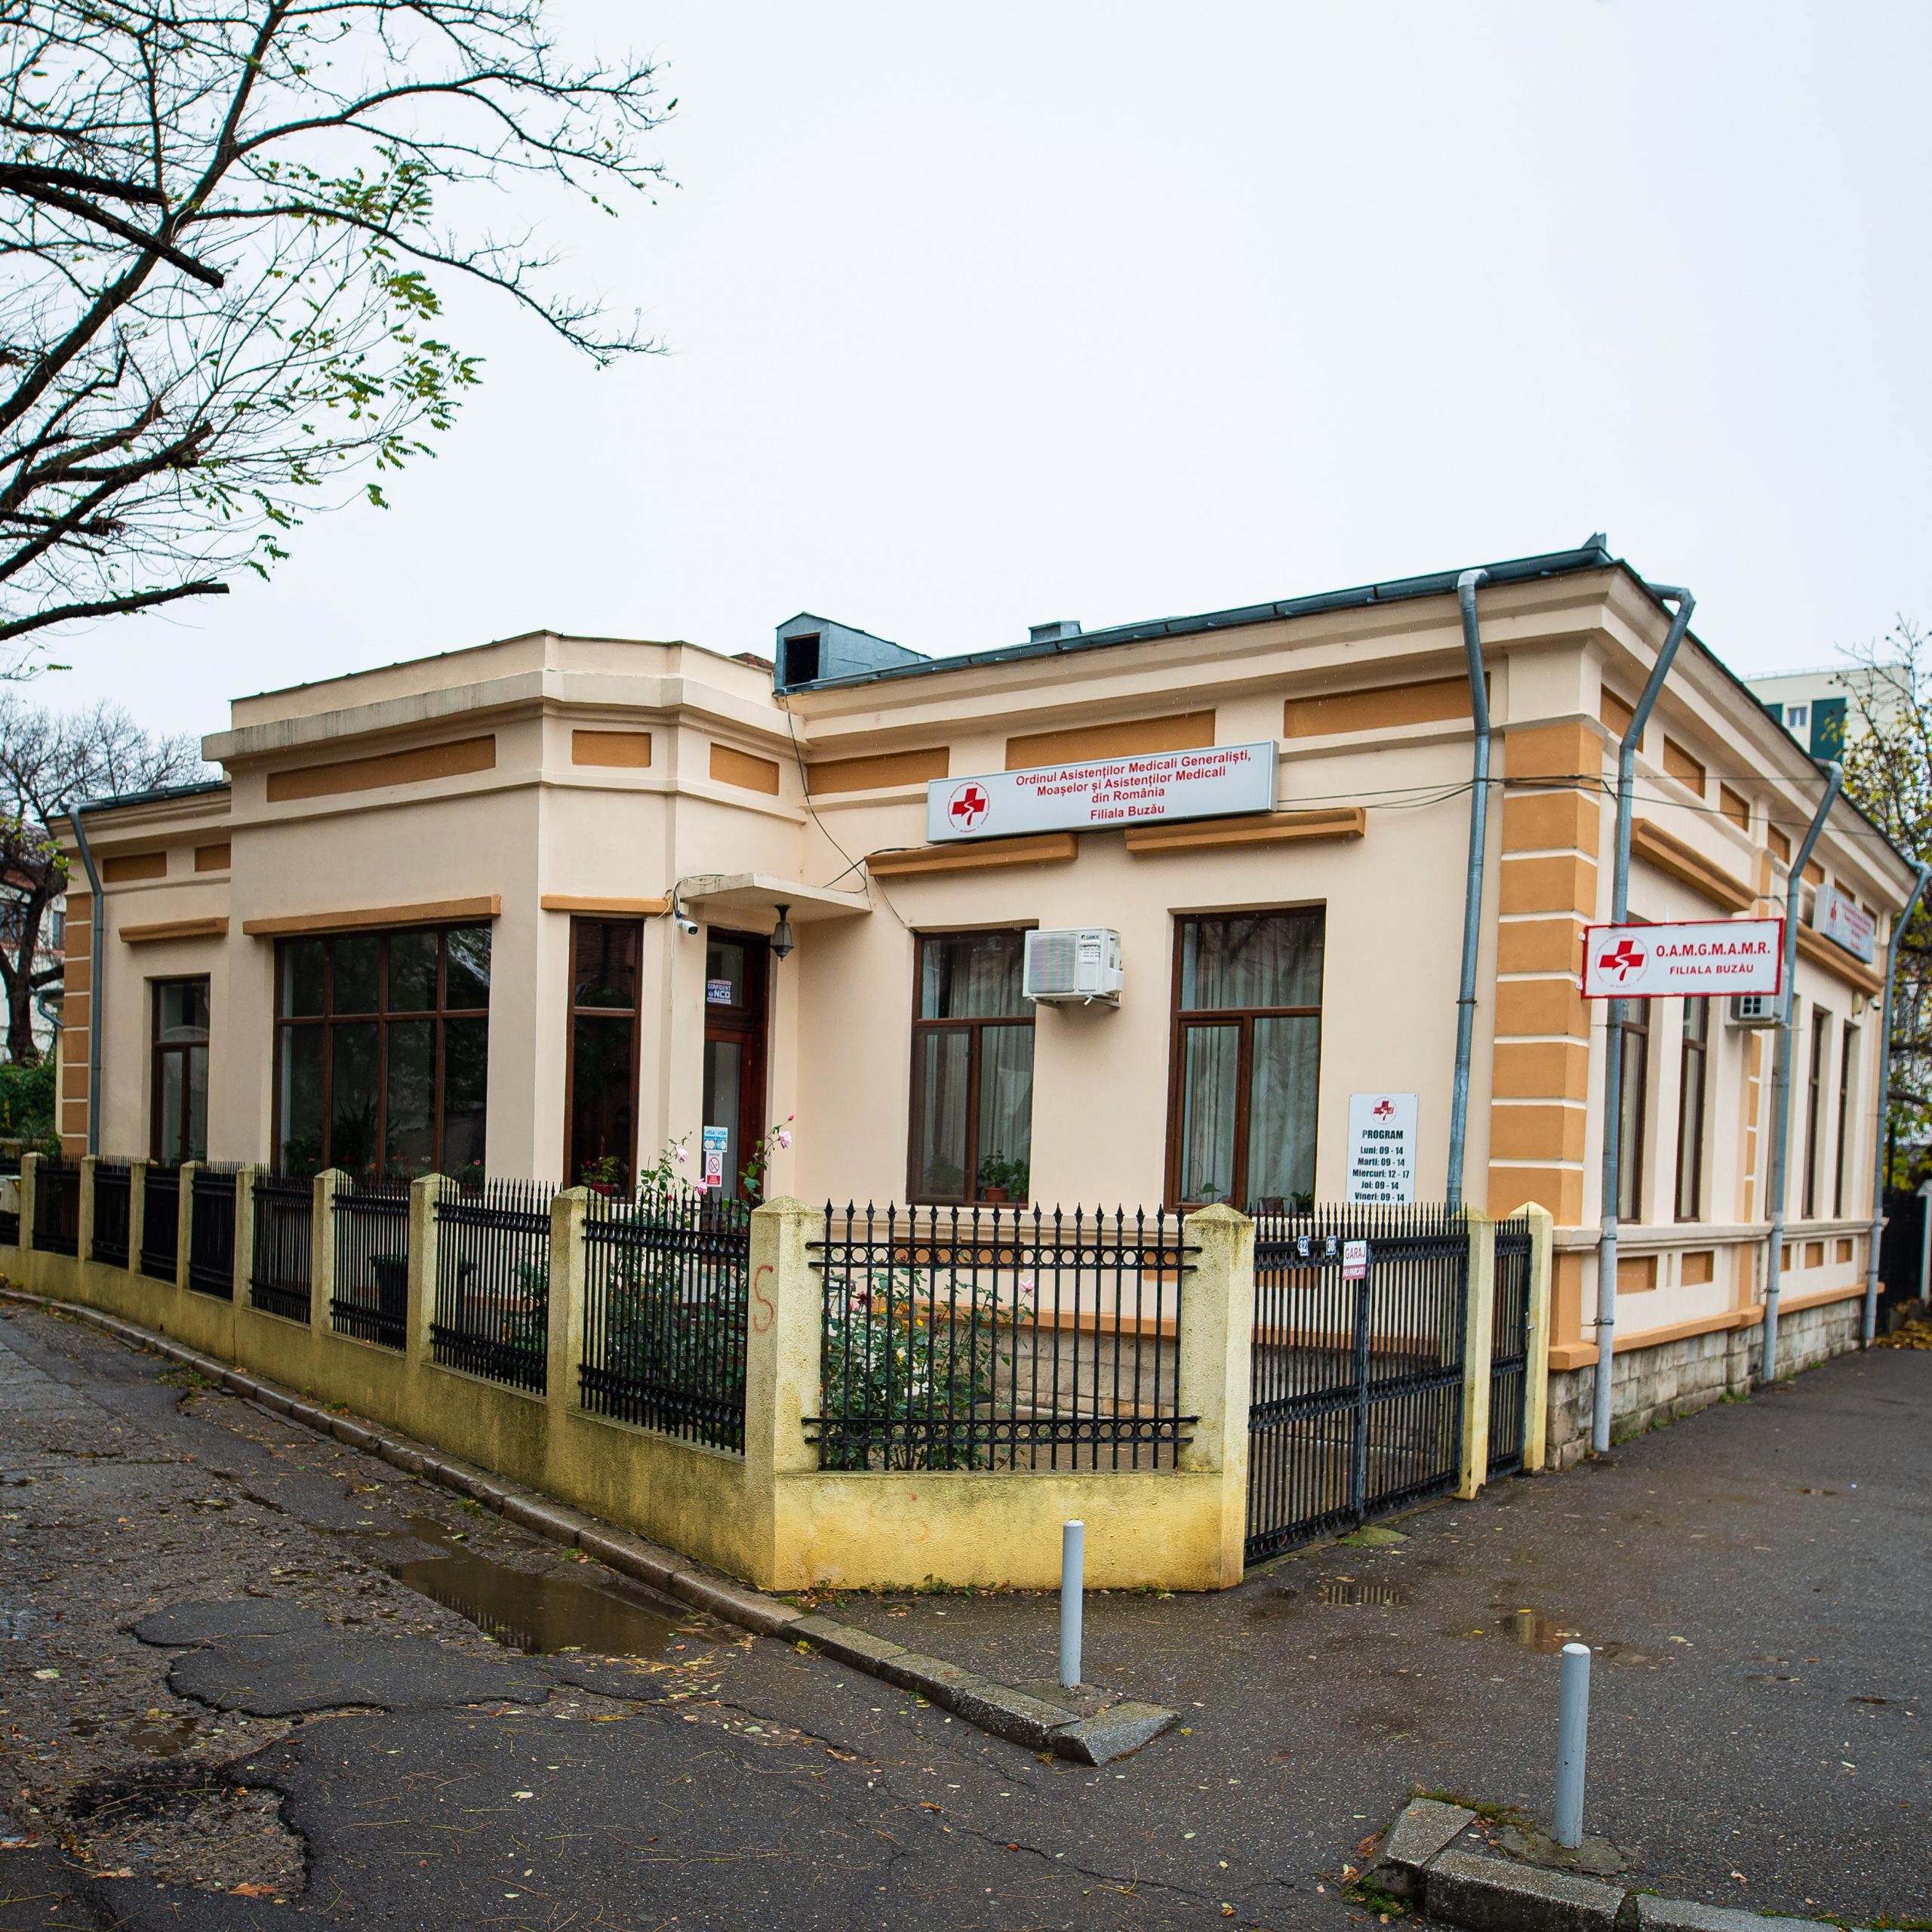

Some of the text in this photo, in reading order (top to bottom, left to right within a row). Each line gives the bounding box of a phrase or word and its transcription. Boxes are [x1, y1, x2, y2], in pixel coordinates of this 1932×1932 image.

[1016, 749, 1251, 786] Ordinul Asistenților Medicali Generaliști,
[1037, 765, 1226, 797] Moașelor și Asistenților Medicali
[1092, 786, 1165, 803] din România
[1091, 803, 1164, 820] Filiala Buzău
[1656, 942, 1770, 958] O.A.M.G.M.A.M.R.
[1669, 965, 1712, 975] FILIALA
[1362, 1130, 1404, 1140] PROGRAM
[1360, 1146, 1378, 1154] Luni:
[1379, 1146, 1389, 1155] 09
[1395, 1146, 1404, 1155] 14
[1380, 1158, 1391, 1166] 09
[1397, 1158, 1405, 1167] 14
[1352, 1169, 1386, 1177] Miercuri:
[1388, 1170, 1396, 1178] 12
[1402, 1170, 1410, 1179] 17
[1361, 1180, 1374, 1189] Joi:
[1374, 1181, 1385, 1189] 09
[1391, 1181, 1398, 1190] 14
[1355, 1192, 1379, 1201] Vineri:
[1380, 1192, 1390, 1201] 09
[1397, 1193, 1404, 1202] 14
[1299, 1238, 1335, 1253] 32 30
[1345, 1247, 1366, 1260] GARAJ
[753, 1263, 774, 1335] S
